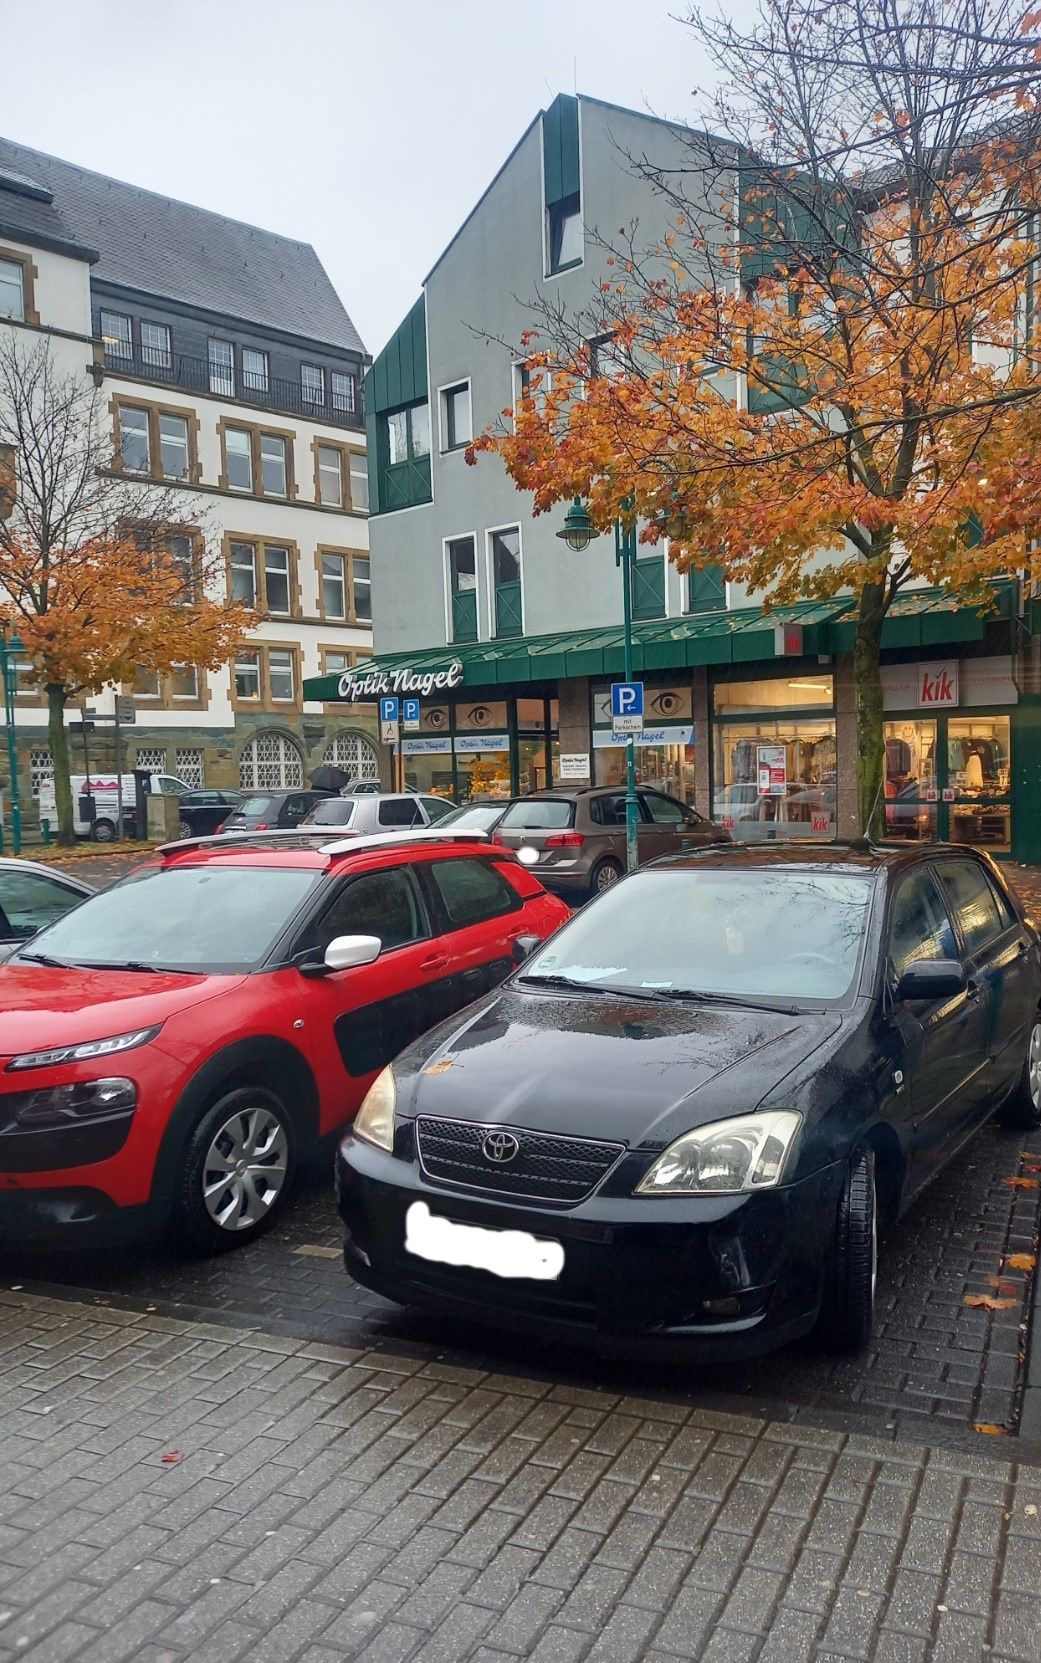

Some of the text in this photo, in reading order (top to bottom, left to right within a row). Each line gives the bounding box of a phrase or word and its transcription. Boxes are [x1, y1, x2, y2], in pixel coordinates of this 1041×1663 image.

[338, 663, 464, 701] Optik Nagel
[384, 700, 395, 719] P
[407, 702, 416, 718] P
[619, 687, 636, 714] P
